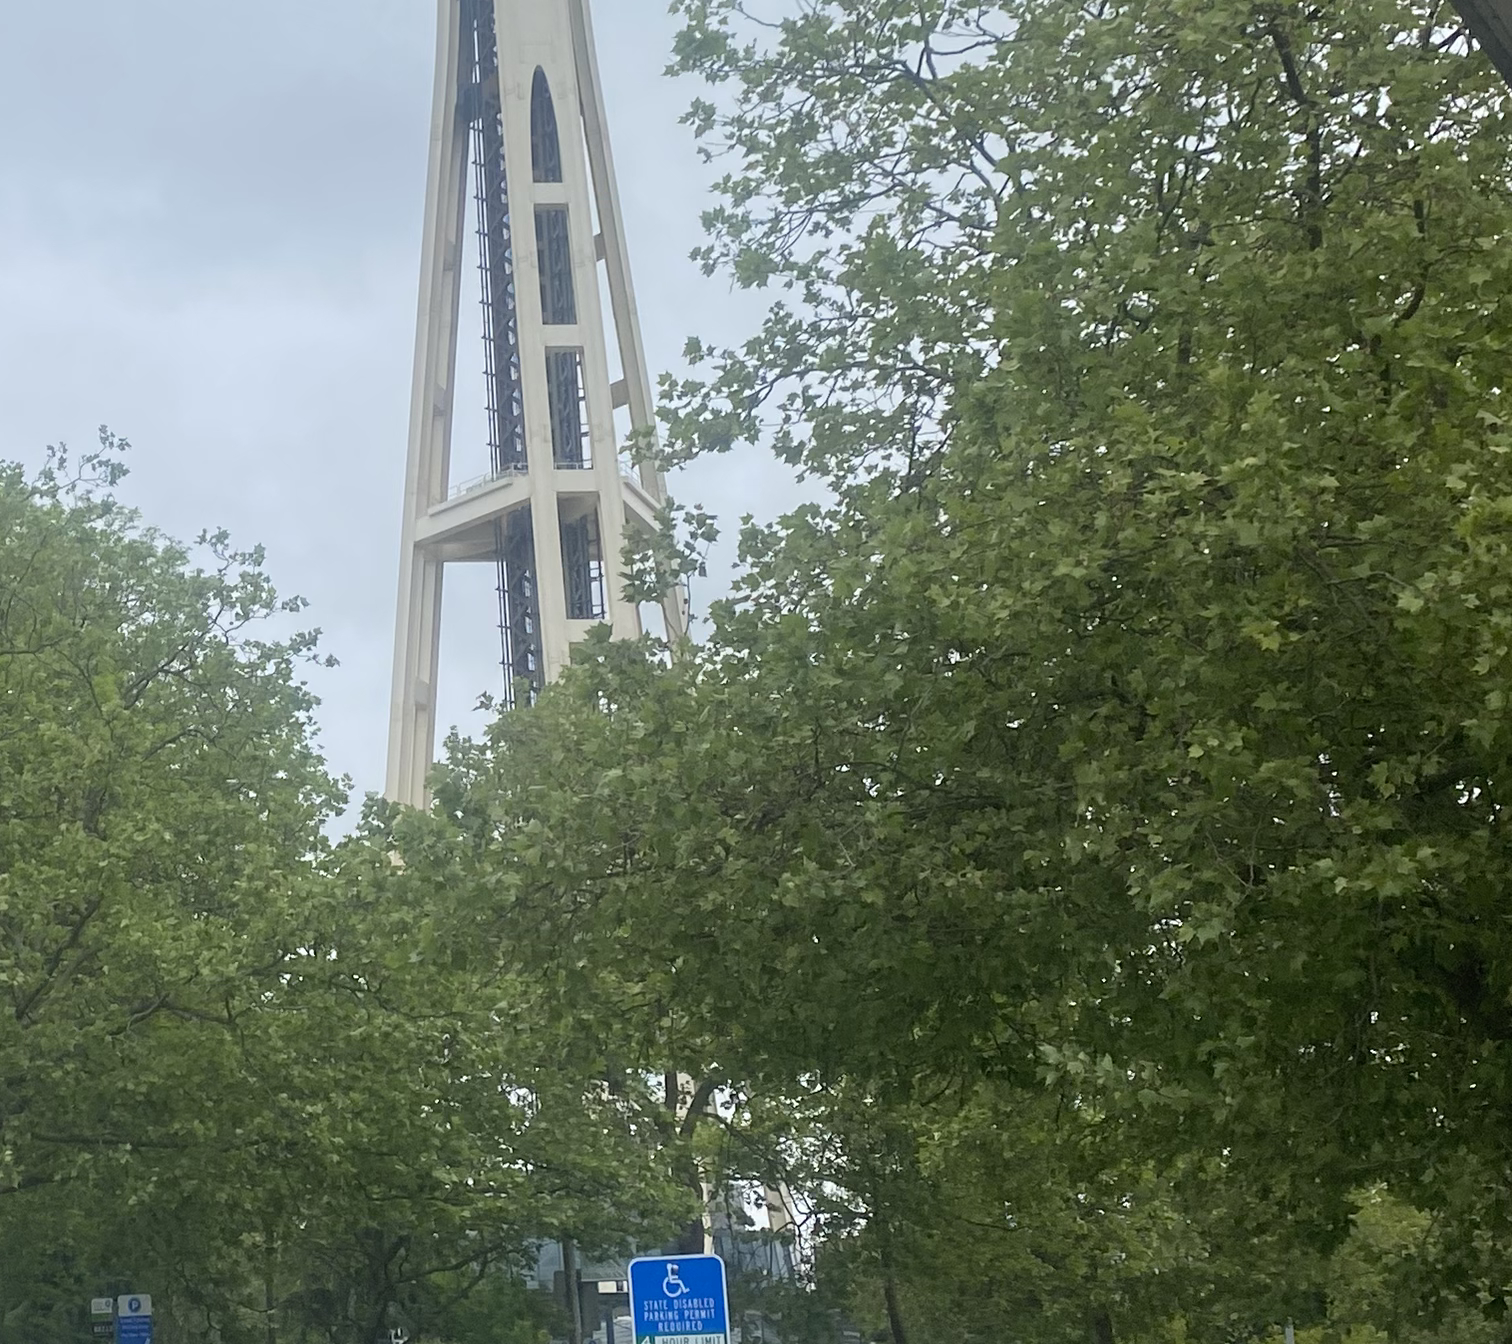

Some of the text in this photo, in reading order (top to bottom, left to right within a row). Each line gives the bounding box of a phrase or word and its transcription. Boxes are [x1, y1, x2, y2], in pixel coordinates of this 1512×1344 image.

[643, 1297, 715, 1311] STATE DISABLED
[643, 1308, 715, 1321] PARKING PERMIT
[658, 1320, 703, 1332] REQUIRED
